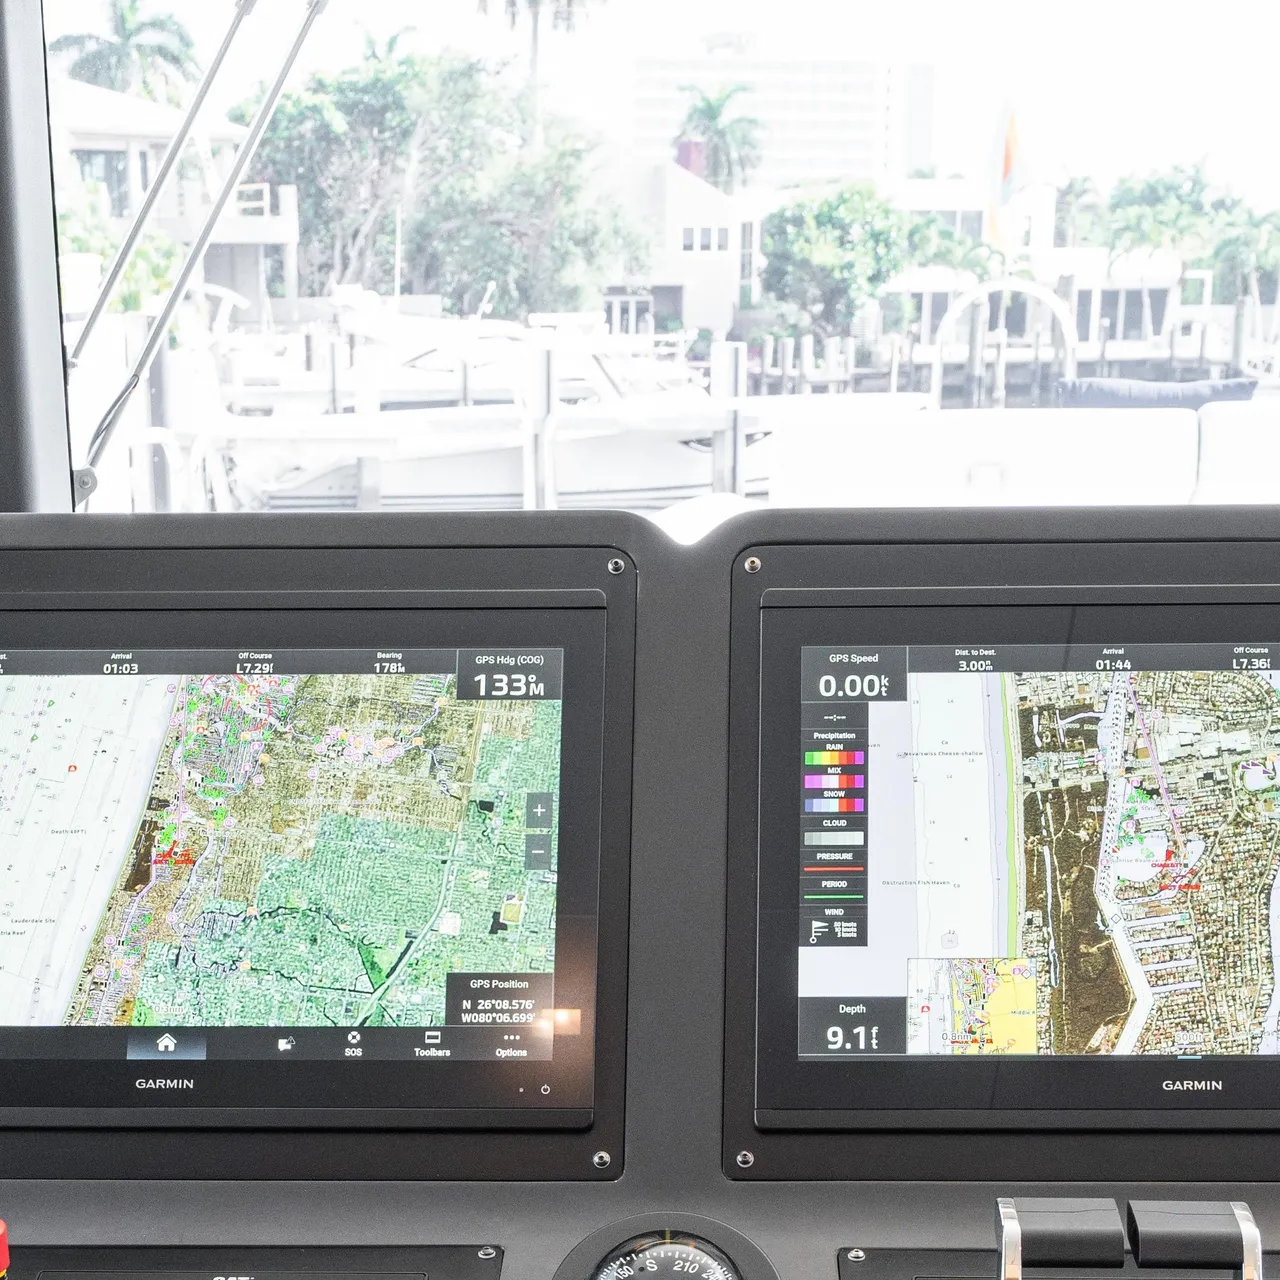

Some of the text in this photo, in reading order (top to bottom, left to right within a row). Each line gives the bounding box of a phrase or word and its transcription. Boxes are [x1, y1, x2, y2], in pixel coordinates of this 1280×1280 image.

[1233, 646, 1269, 654] Off Course
[377, 652, 402, 660] Bearing
[829, 654, 879, 664] GPS Speed
[475, 655, 544, 667] GPS Hdg (COG)
[1095, 659, 1131, 671] 01:44
[103, 663, 139, 674] 01:03
[813, 732, 856, 741] Precipitation
[826, 743, 844, 751] RAIN
[823, 790, 845, 798] SNOW
[822, 819, 847, 827] CLOUD
[816, 852, 853, 860] PRESSURE
[821, 880, 847, 888] PERIOD
[825, 908, 844, 916] WIND
[470, 979, 529, 989] GPS Position
[462, 1000, 471, 1009] N
[839, 1004, 866, 1014] Depth
[344, 1048, 363, 1056] SOS
[414, 1048, 451, 1057] Toolbars
[495, 1048, 528, 1058] Options
[135, 1079, 194, 1089] GARMIN
[1162, 1080, 1222, 1091] GARMIN
[646, 1259, 658, 1271] S
[673, 1260, 699, 1274] 210
[614, 1265, 635, 1280] 150
